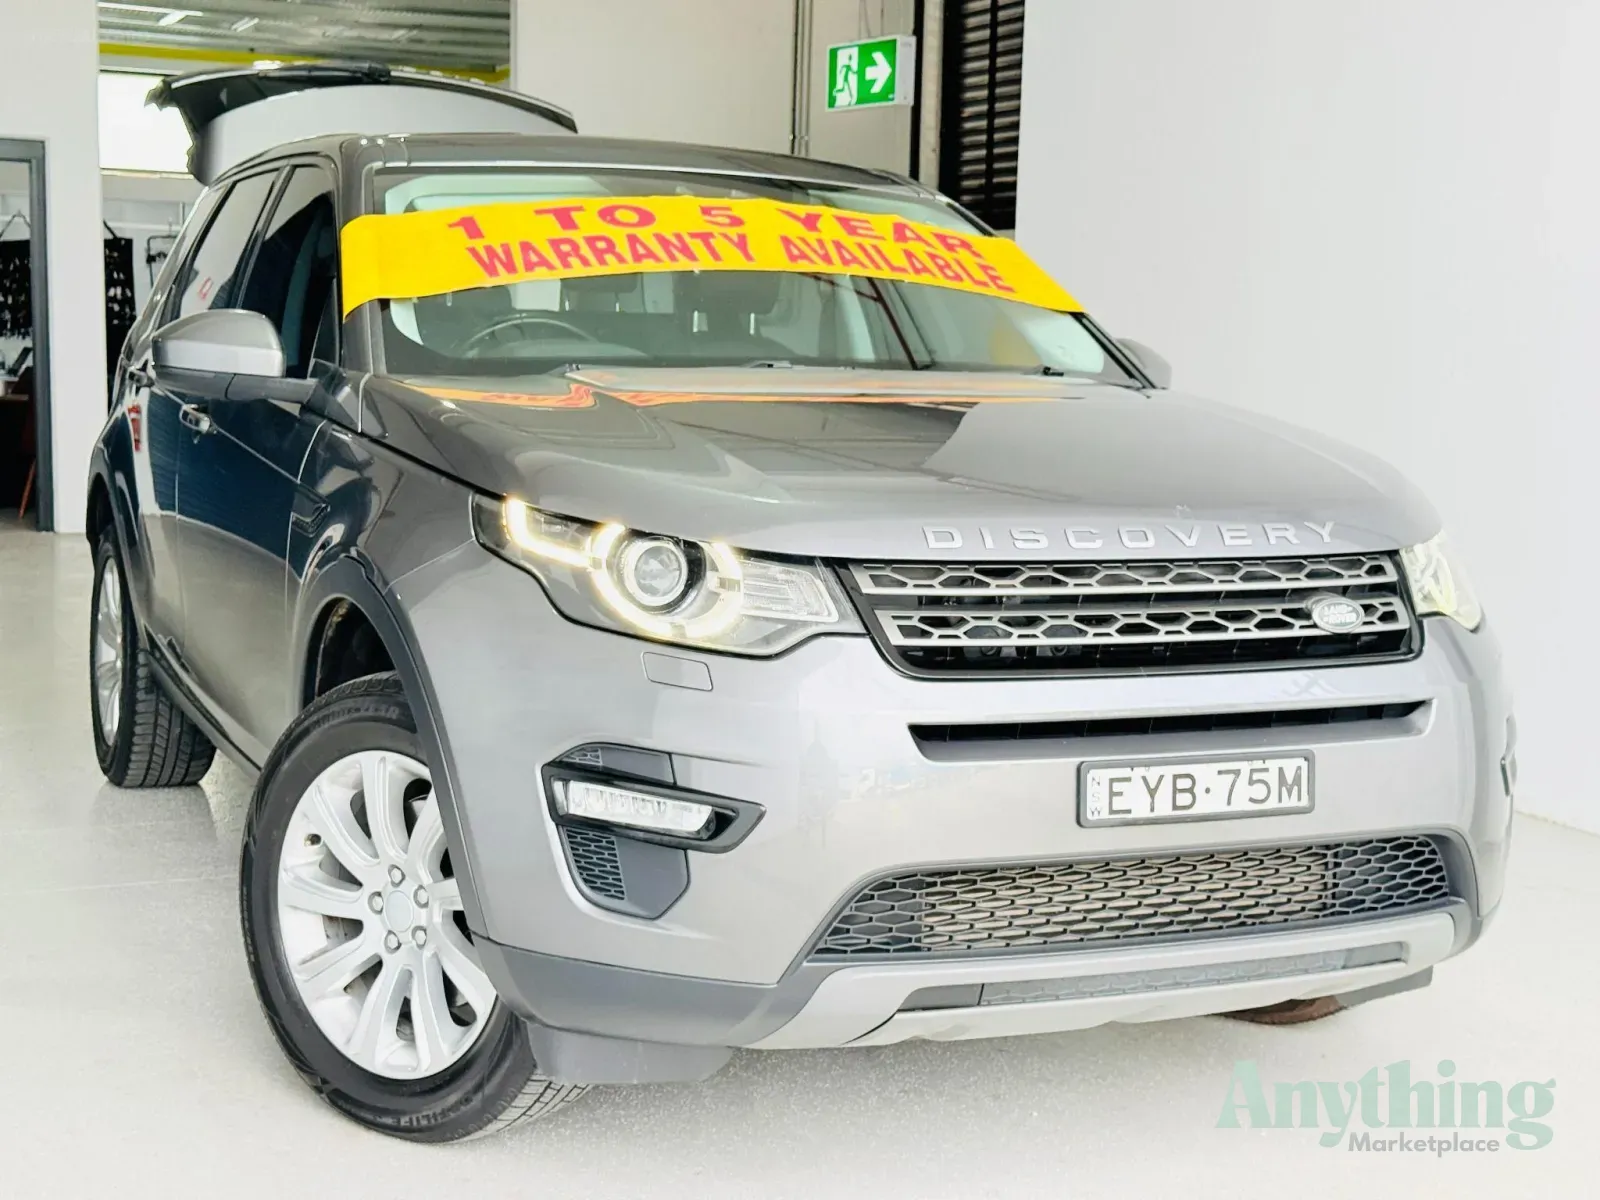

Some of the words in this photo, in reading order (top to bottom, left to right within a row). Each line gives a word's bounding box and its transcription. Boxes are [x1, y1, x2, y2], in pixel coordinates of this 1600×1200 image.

[447, 216, 485, 240] 1
[533, 204, 657, 231] TO
[699, 206, 745, 228] 5
[775, 208, 984, 260] YEAR
[465, 232, 756, 279] WARRANTY
[779, 235, 1017, 293] AVAILABLE
[922, 520, 1335, 550] DISCOVERY
